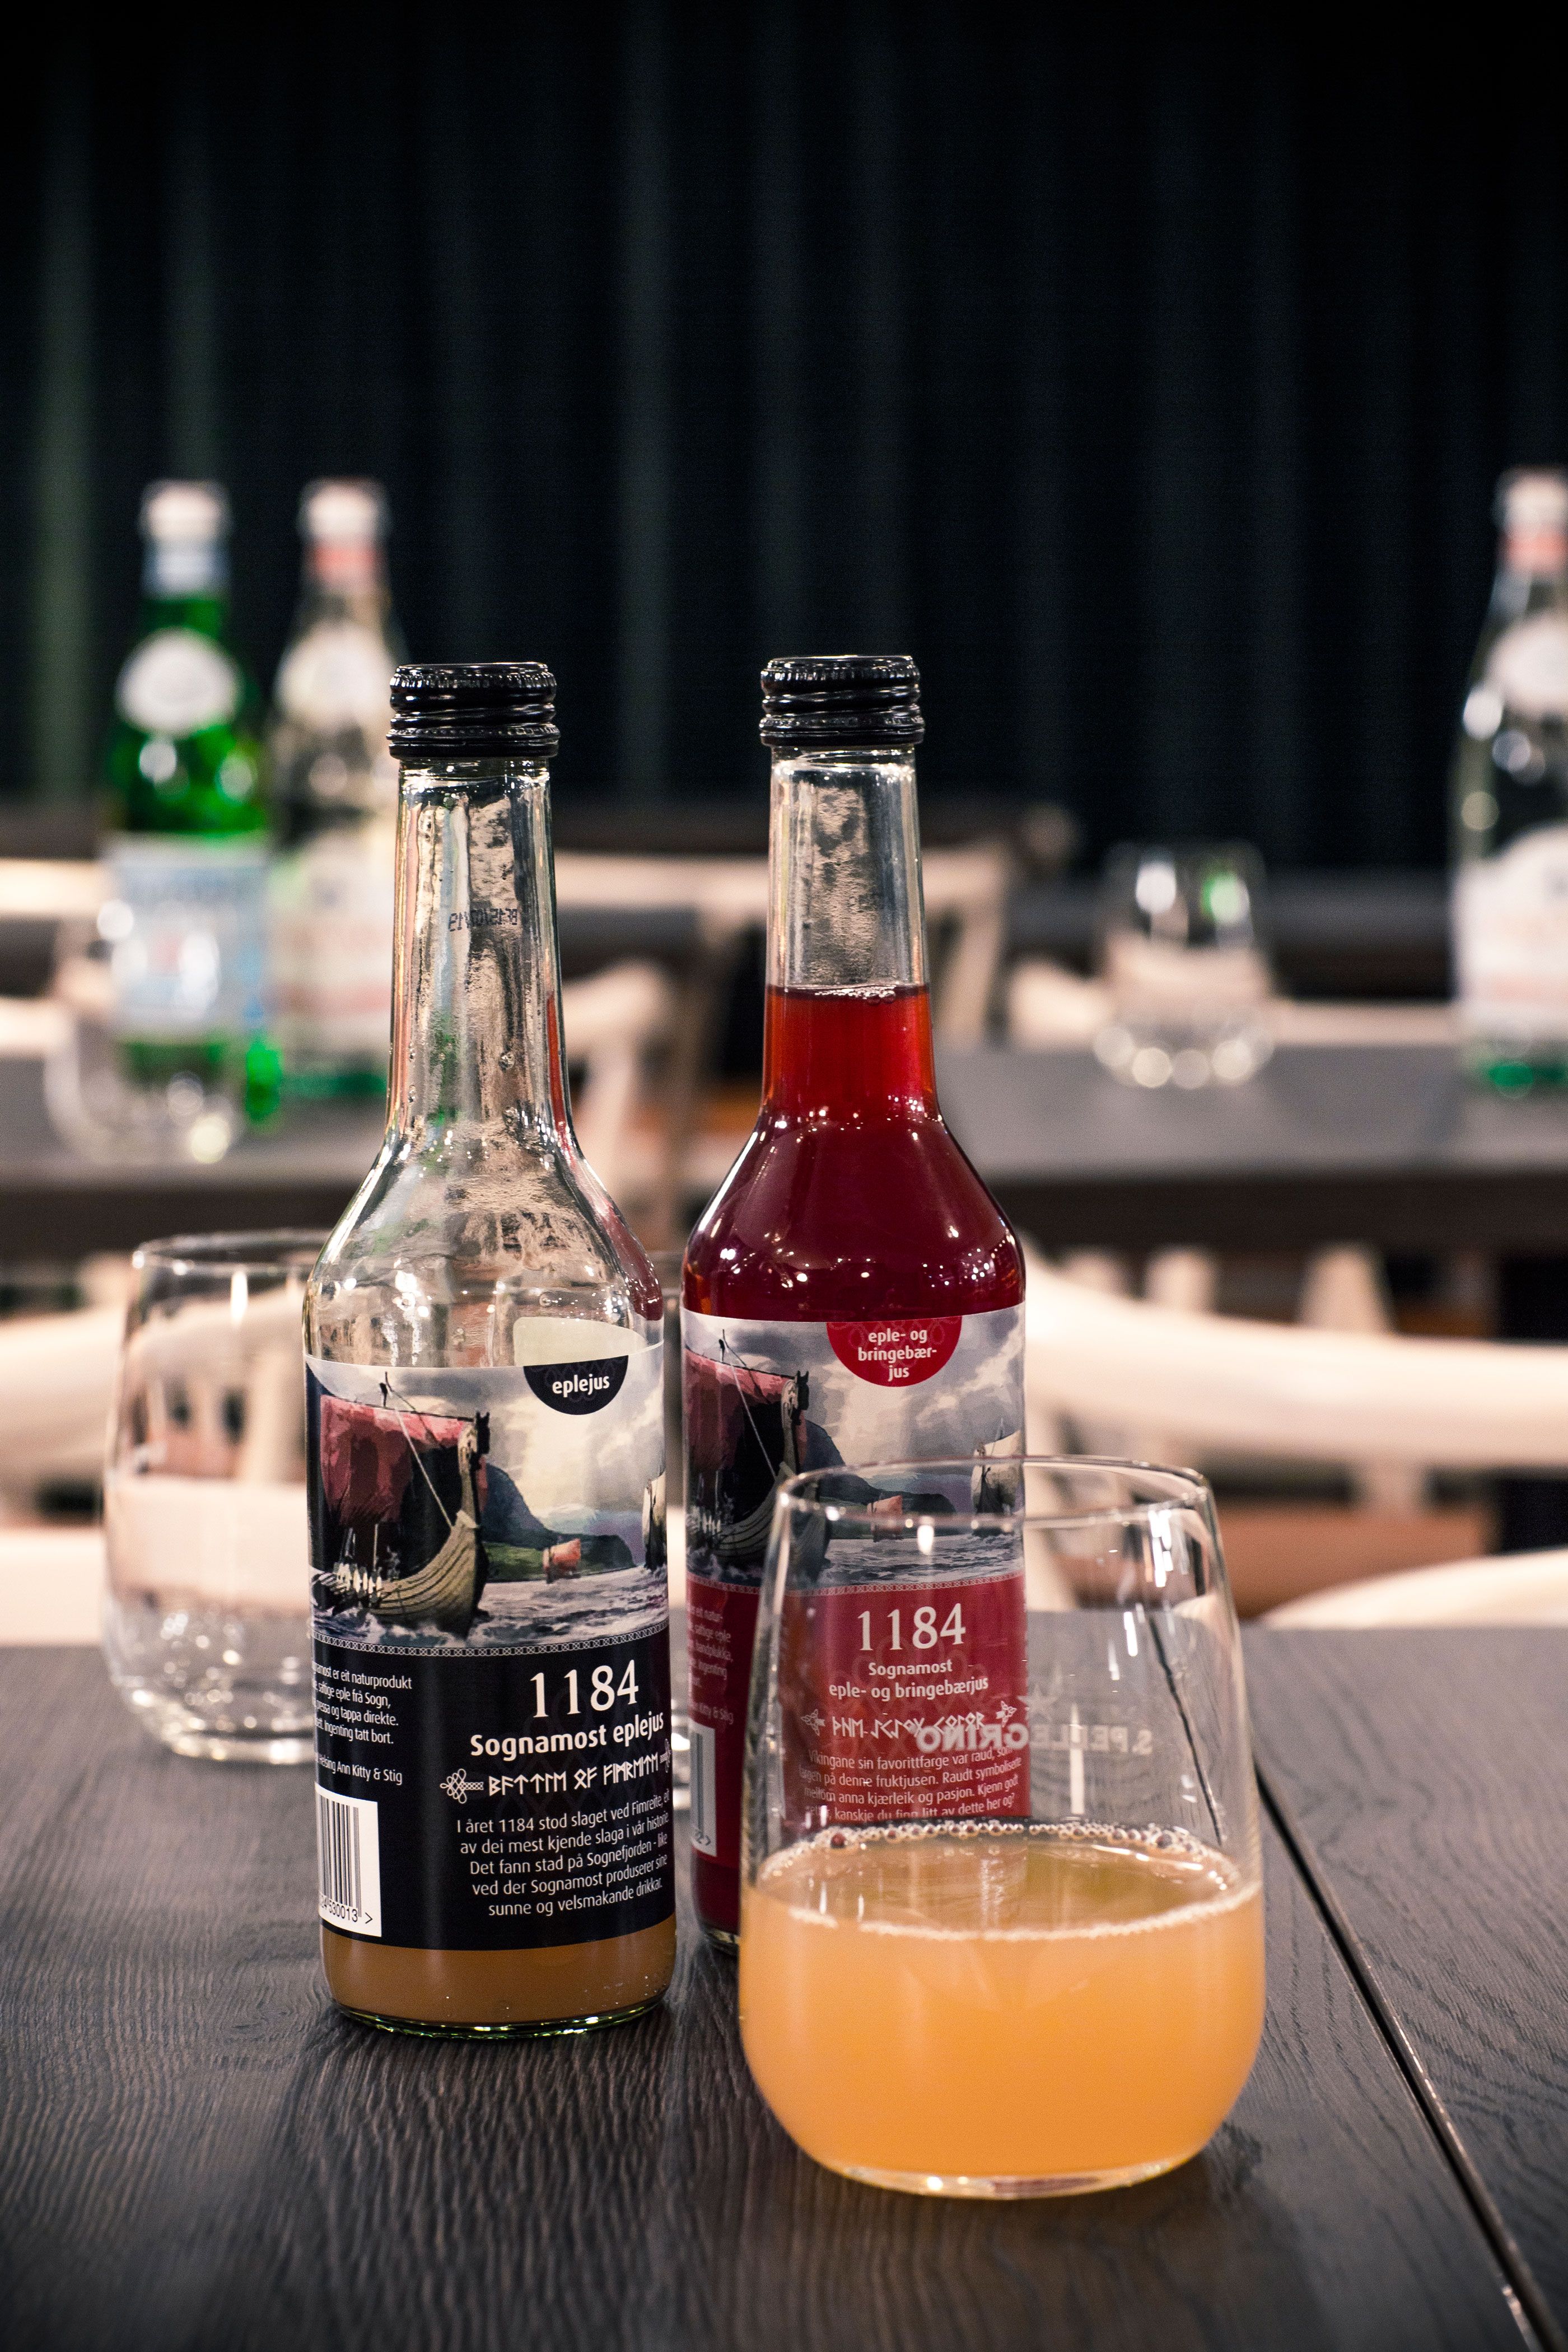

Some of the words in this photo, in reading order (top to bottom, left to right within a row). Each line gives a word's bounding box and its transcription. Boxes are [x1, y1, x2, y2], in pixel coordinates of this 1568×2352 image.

[868, 1328, 906, 1346] eple-
[909, 1329, 927, 1343] og
[858, 1345, 937, 1364] bringebær-
[552, 1373, 610, 1398] eplejus
[888, 1365, 910, 1382] jus
[857, 1603, 967, 1651] 1184
[332, 1669, 339, 1679] er
[340, 1669, 350, 1682] eit
[351, 1674, 413, 1690] naturprodukt
[868, 1659, 953, 1679] Sognamost
[335, 1687, 351, 1702] eple
[352, 1688, 363, 1703] frå
[365, 1692, 391, 1709] Sogn,
[529, 1659, 639, 1718] 1184
[829, 1682, 867, 1700] eple-
[871, 1685, 890, 1702] og
[895, 1676, 989, 1701] bringebærjus
[331, 1706, 339, 1720] og
[340, 1706, 362, 1723] tappa
[363, 1710, 399, 1726] direkte.
[324, 1719, 353, 1742] Ingenting
[354, 1728, 370, 1742] tatt
[371, 1729, 394, 1744] bort.
[470, 1724, 607, 1762] Sognamost
[613, 1711, 664, 1747] eplejus
[858, 1756, 874, 1770] sin
[876, 1755, 949, 1770] favorittfarge
[952, 1753, 968, 1765] var
[970, 1746, 995, 1762] raud,
[337, 1761, 351, 1775] Ann
[352, 1764, 371, 1782] Kitty
[373, 1768, 381, 1780] &
[383, 1769, 403, 1786] Stig
[824, 1772, 836, 1786] på
[839, 1772, 872, 1787] denne
[876, 1775, 939, 1790] fruktjusen.
[942, 1767, 973, 1784] Raudt
[838, 1793, 865, 1804] anna
[868, 1791, 914, 1808] kjærleik
[918, 1793, 934, 1805] og
[936, 1787, 975, 1804] pasjon.
[977, 1781, 1003, 1797] Kjenn
[457, 1820, 461, 1833] I
[465, 1818, 494, 1833] året
[499, 1818, 534, 1832] 1184
[539, 1813, 567, 1831] stod
[571, 1809, 608, 1828] slaget
[610, 1802, 629, 1819] ved
[631, 1794, 664, 1816] Fimreite,
[834, 1807, 875, 1822] kanskje
[941, 1808, 955, 1816] av
[958, 1802, 985, 1816] dette
[986, 1798, 1001, 1811] her
[460, 1842, 477, 1854] av
[482, 1838, 504, 1854] dei
[508, 1837, 544, 1853] mest
[547, 1831, 597, 1854] kjende
[595, 1828, 624, 1846] slaga
[626, 1824, 630, 1838] i
[631, 1820, 646, 1836] vår
[469, 1861, 495, 1875] Det
[499, 1859, 531, 1874] fann
[534, 1855, 563, 1872] stad
[567, 1853, 584, 1873] på
[586, 1840, 652, 1868] Sognefjorden
[472, 1880, 498, 1895] ved
[503, 1879, 526, 1894] der
[530, 1872, 603, 1896] Sognamost
[606, 1860, 654, 1887] produserer
[488, 1903, 531, 1916] sunne
[536, 1901, 553, 1917] og
[558, 1886, 634, 1912] velsmakande
[636, 1877, 663, 1897] drikkar.
